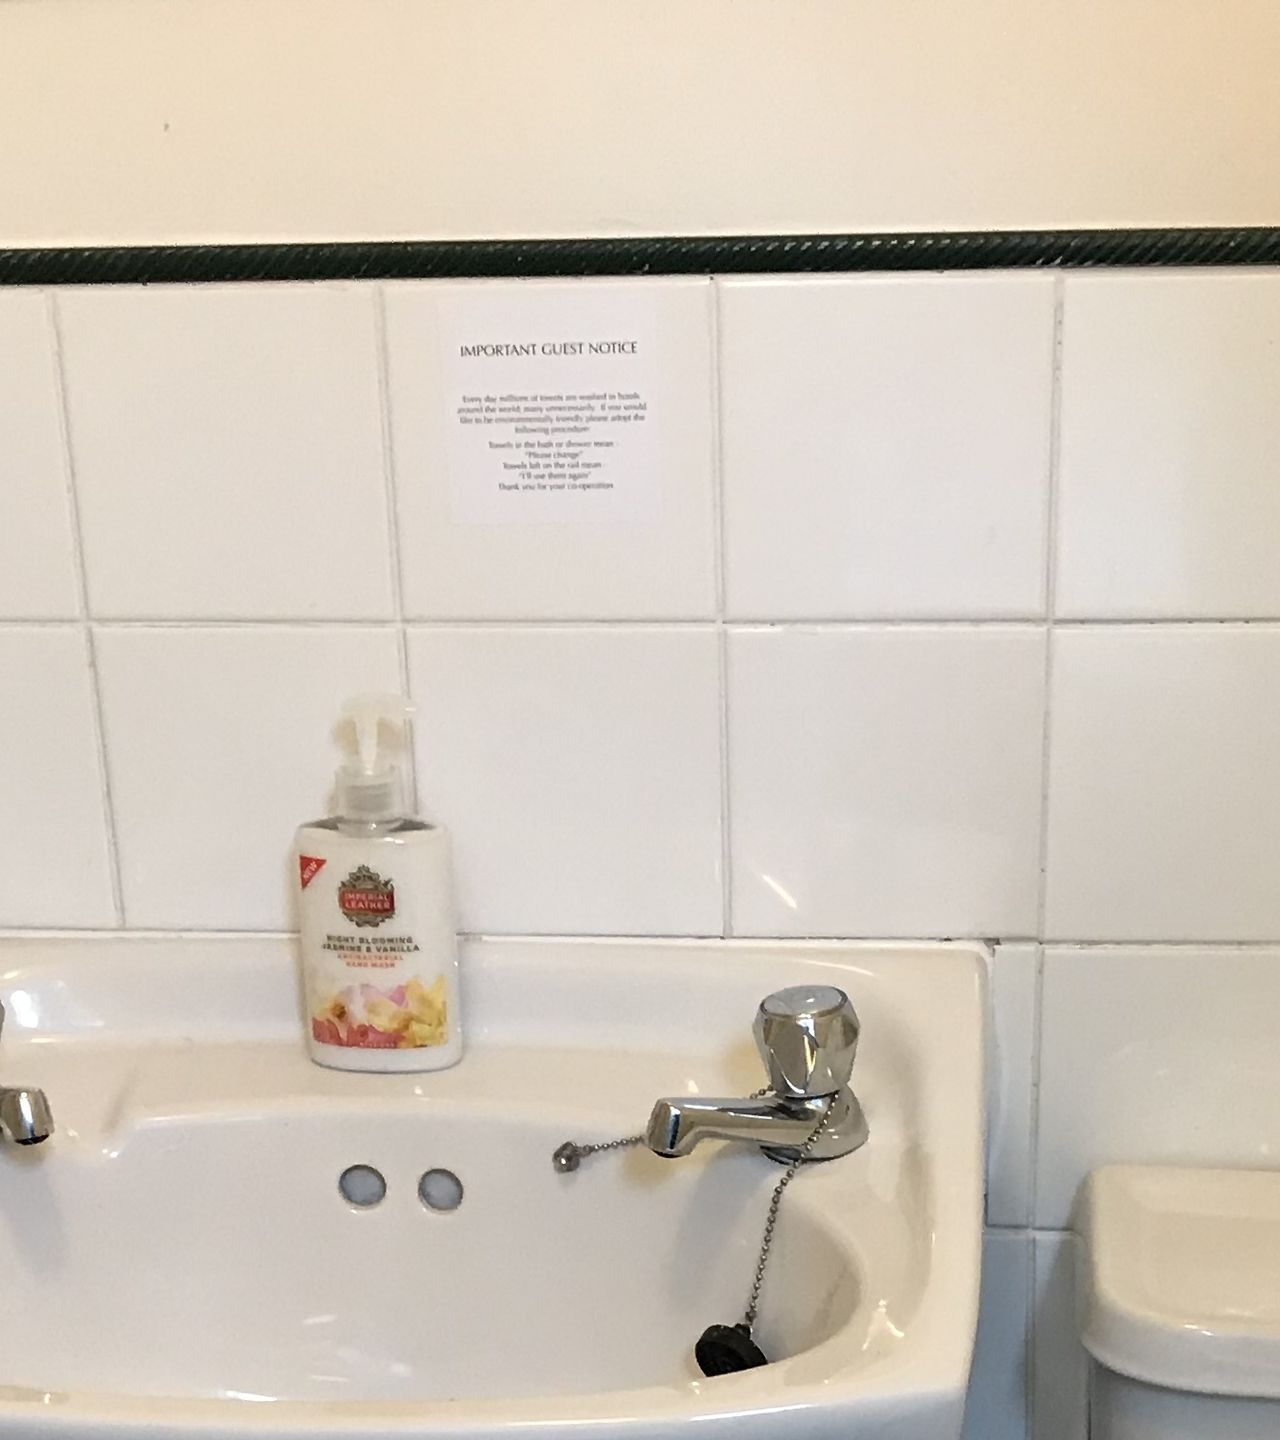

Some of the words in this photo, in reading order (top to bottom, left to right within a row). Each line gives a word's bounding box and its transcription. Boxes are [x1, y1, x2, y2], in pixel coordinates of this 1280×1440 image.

[460, 343, 536, 357] IMPORTANT
[541, 342, 584, 355] GUEST
[589, 341, 638, 354] NOTICE
[303, 860, 318, 880] NEW
[344, 892, 390, 900] IMPERIAL
[345, 901, 390, 909] LEATHER
[359, 936, 413, 944] BLOOMING
[322, 943, 362, 952] JASMINE
[376, 944, 420, 952] VANILLA
